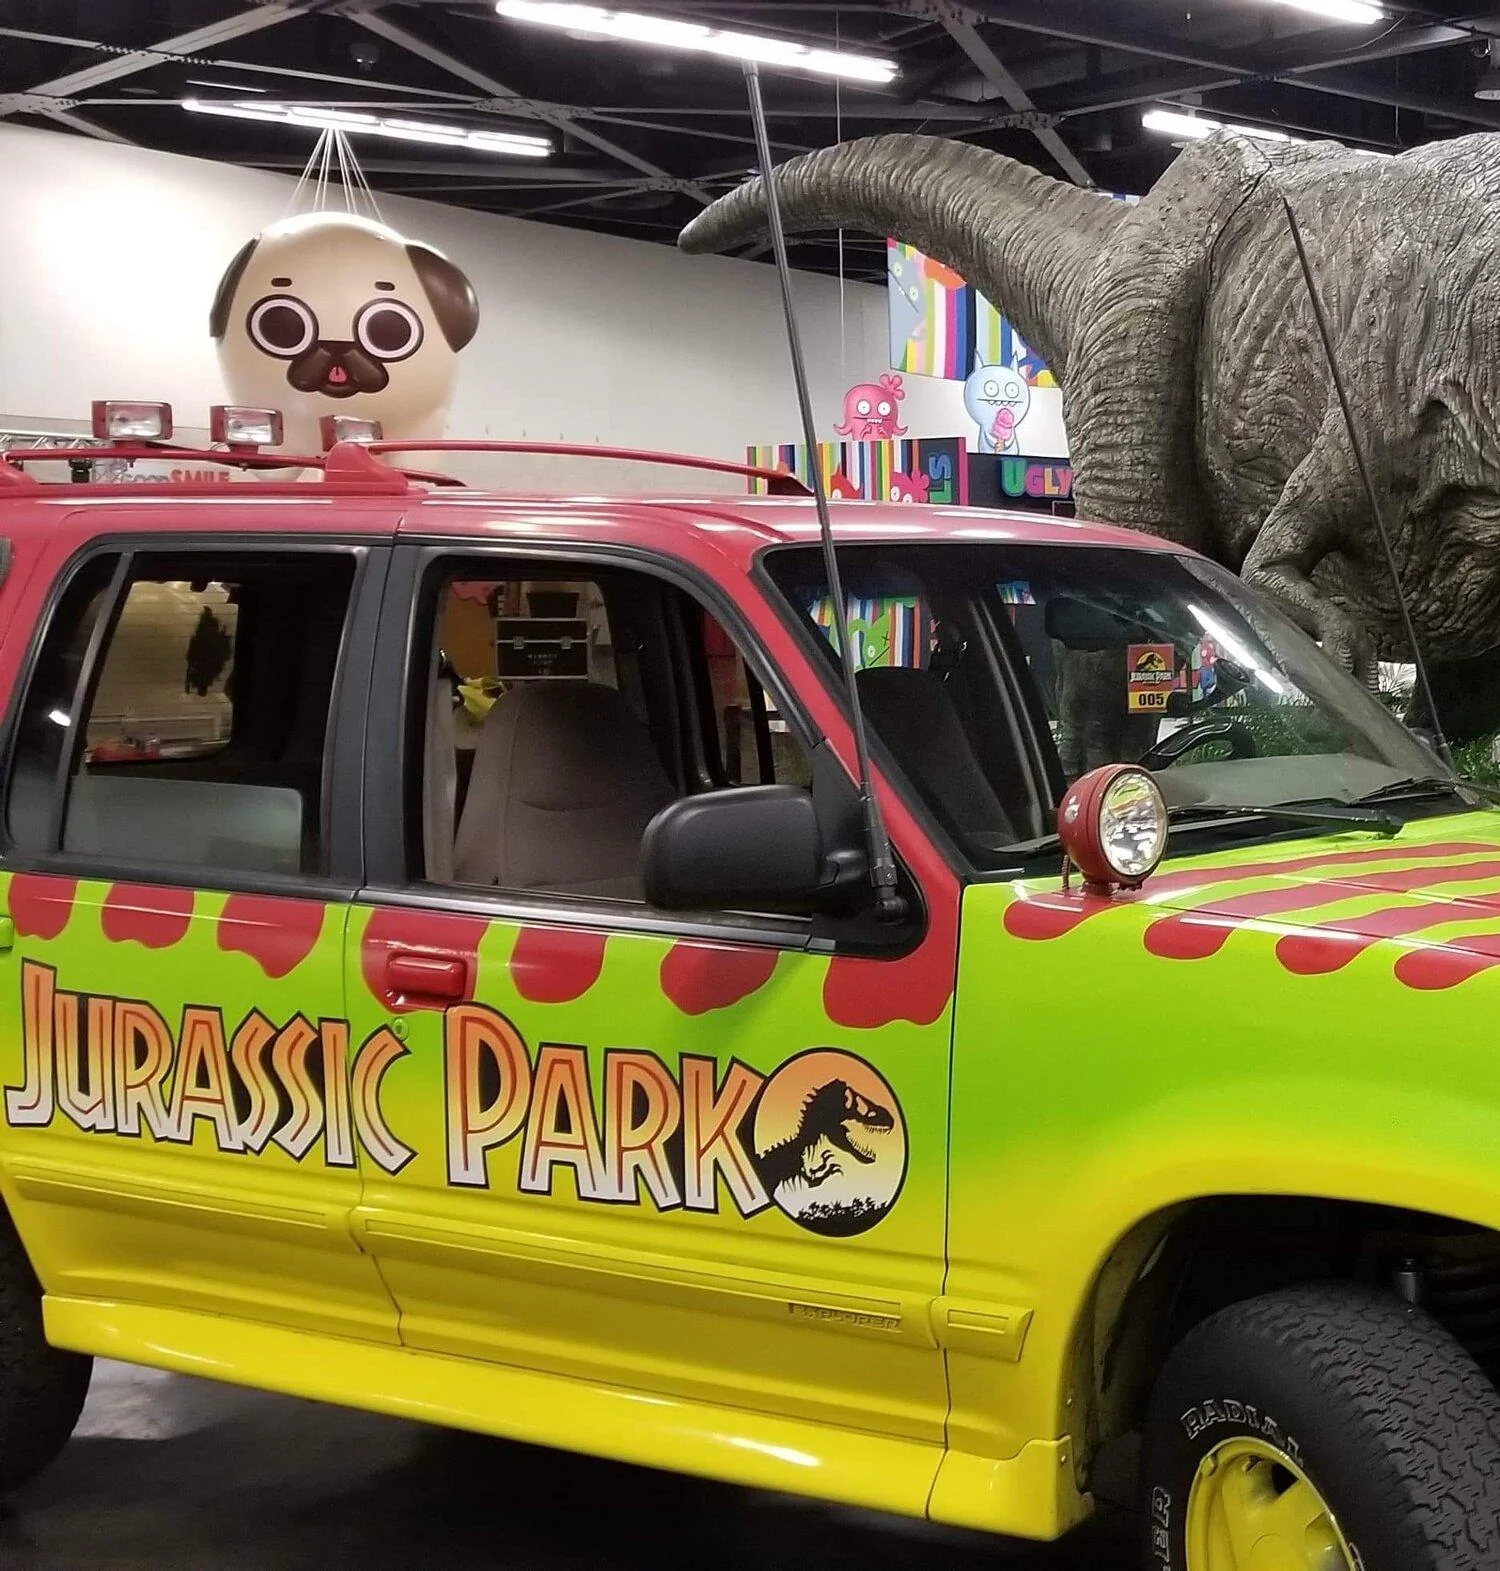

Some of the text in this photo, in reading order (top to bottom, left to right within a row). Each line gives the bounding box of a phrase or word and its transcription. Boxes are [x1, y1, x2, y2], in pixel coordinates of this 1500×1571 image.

[1000, 457, 1075, 499] UGLY
[1138, 692, 1165, 706] 005
[2, 957, 778, 1219] JURASSIC PARK
[1179, 1399, 1305, 1469] RADIAL
